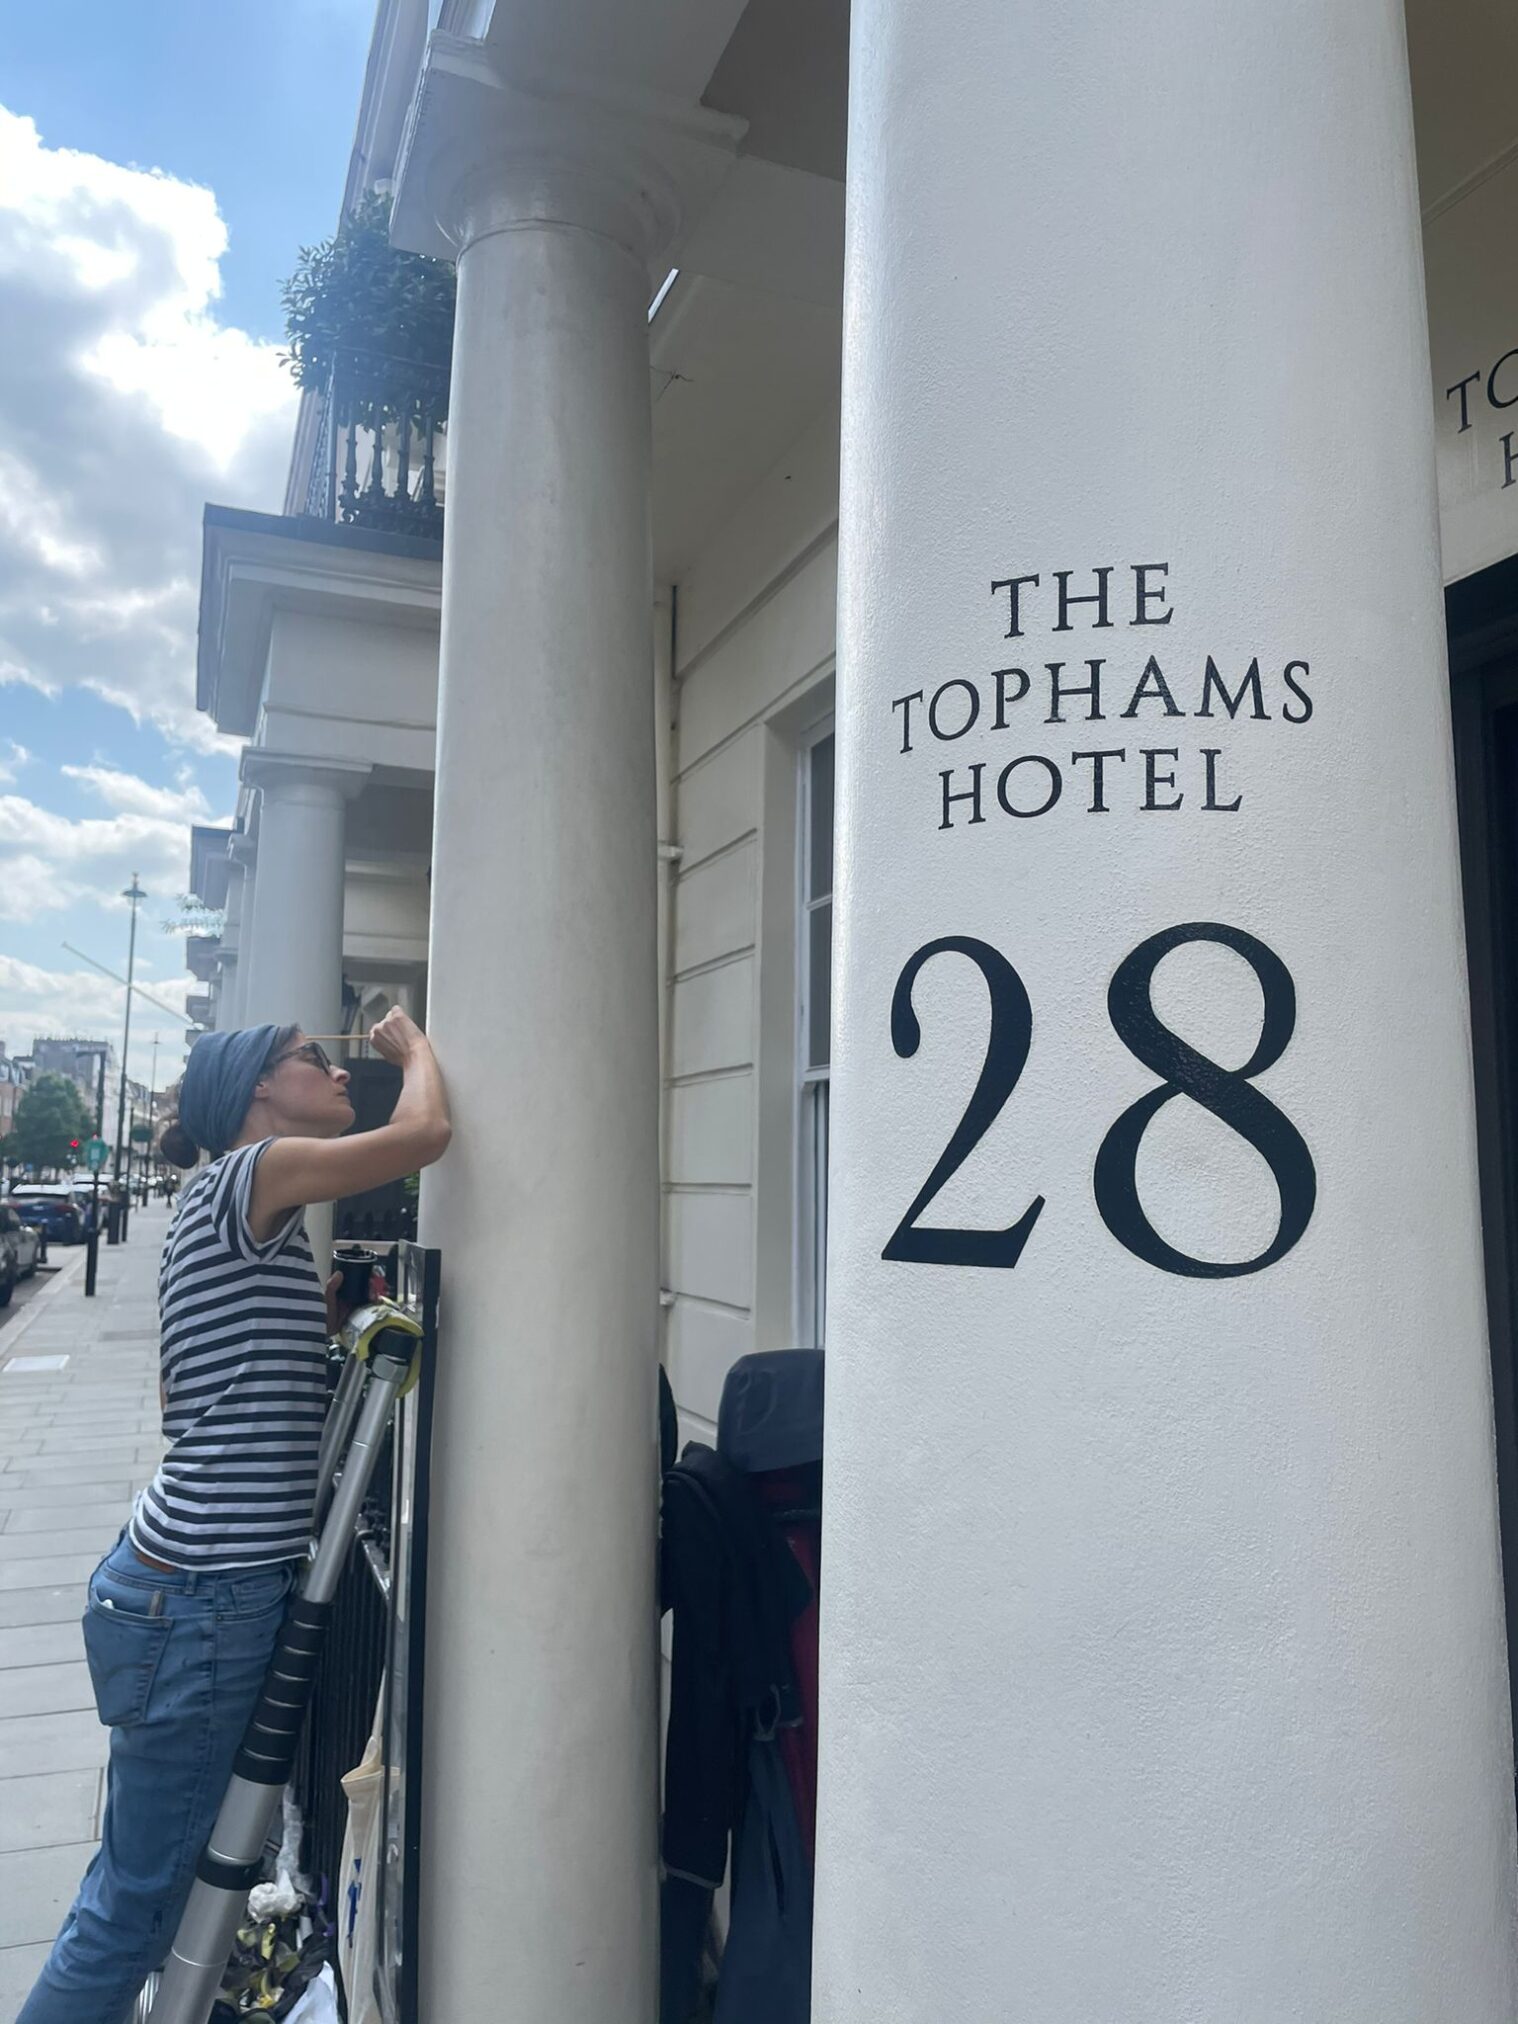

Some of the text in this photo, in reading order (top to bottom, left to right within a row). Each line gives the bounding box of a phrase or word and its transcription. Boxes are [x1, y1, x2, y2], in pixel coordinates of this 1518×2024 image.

[990, 562, 1174, 639] THE
[892, 654, 1313, 755] TOPHAMS
[937, 747, 1243, 831] HOTEL
[880, 921, 1317, 1280] 28
